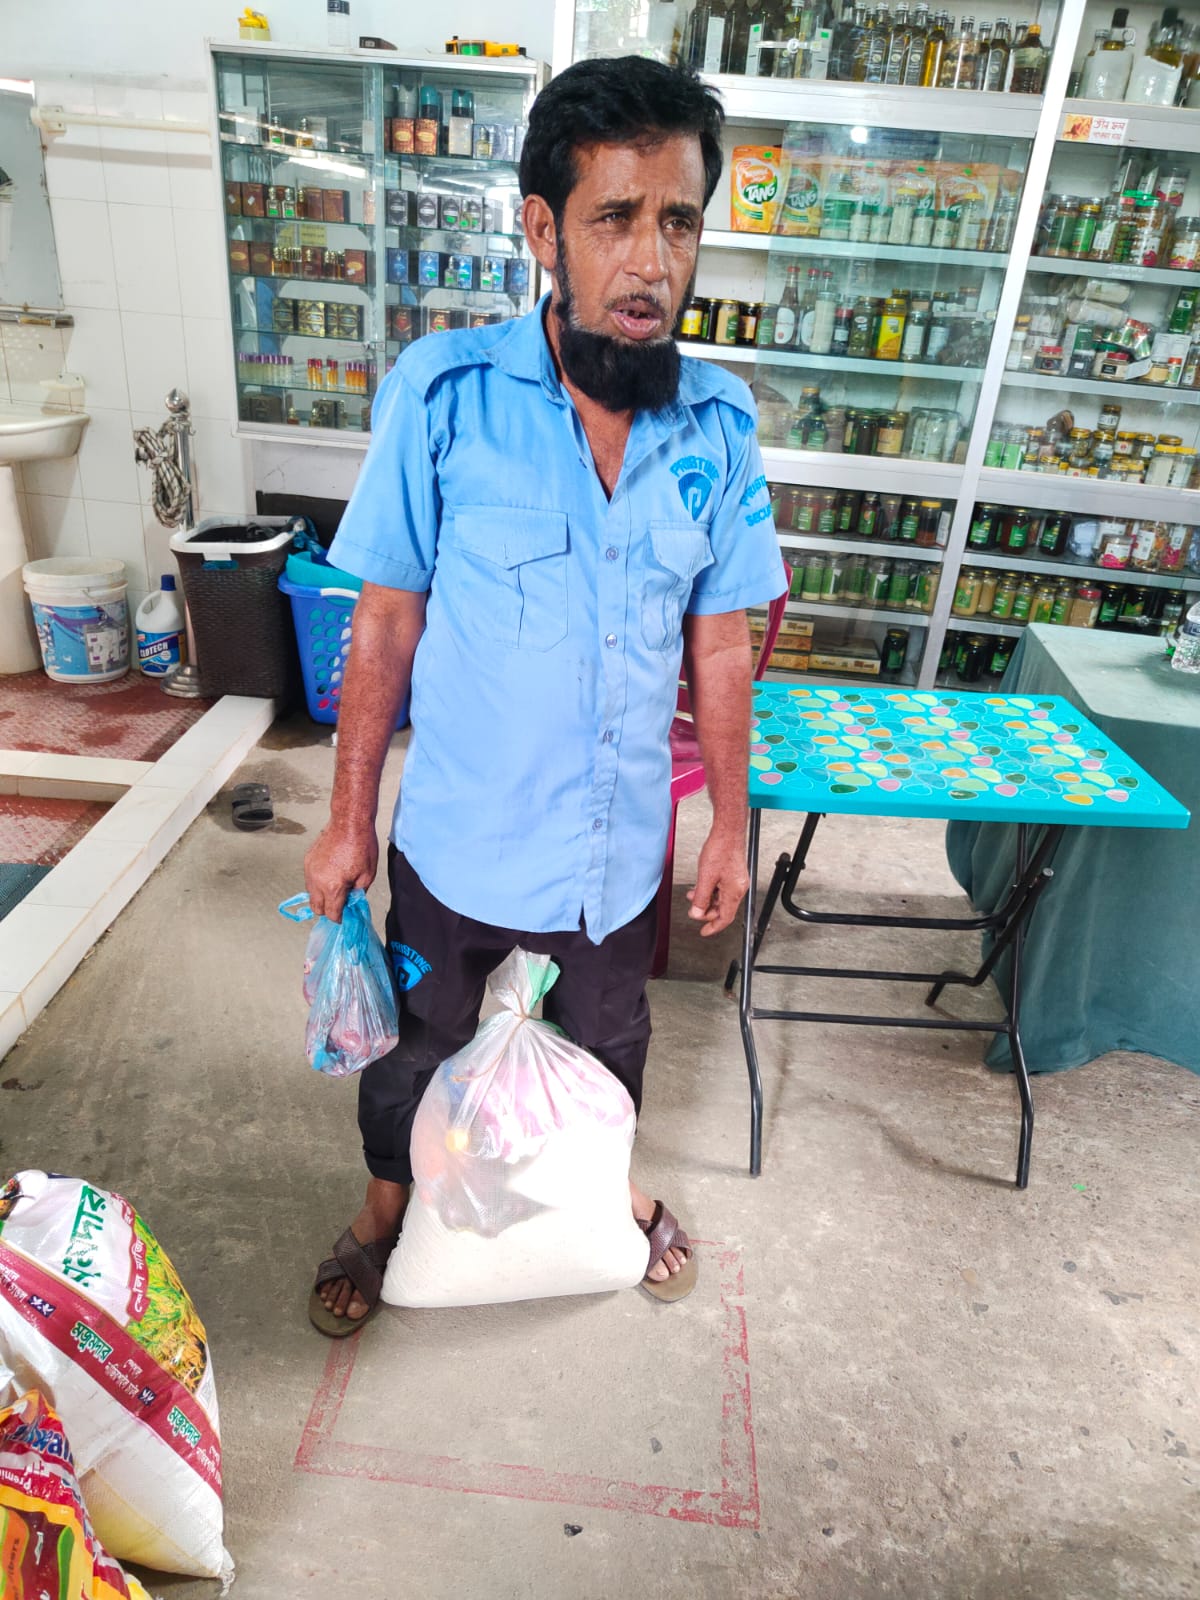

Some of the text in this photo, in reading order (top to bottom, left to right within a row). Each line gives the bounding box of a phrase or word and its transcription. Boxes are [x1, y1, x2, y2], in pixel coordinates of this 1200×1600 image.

[745, 182, 775, 202] TANG
[788, 190, 816, 208] TANG
[669, 455, 720, 482] PRISTINE
[390, 940, 433, 974] PRISTINE
[70, 1320, 114, 1362] মজুমদার
[166, 1406, 203, 1448] মজুমদার
